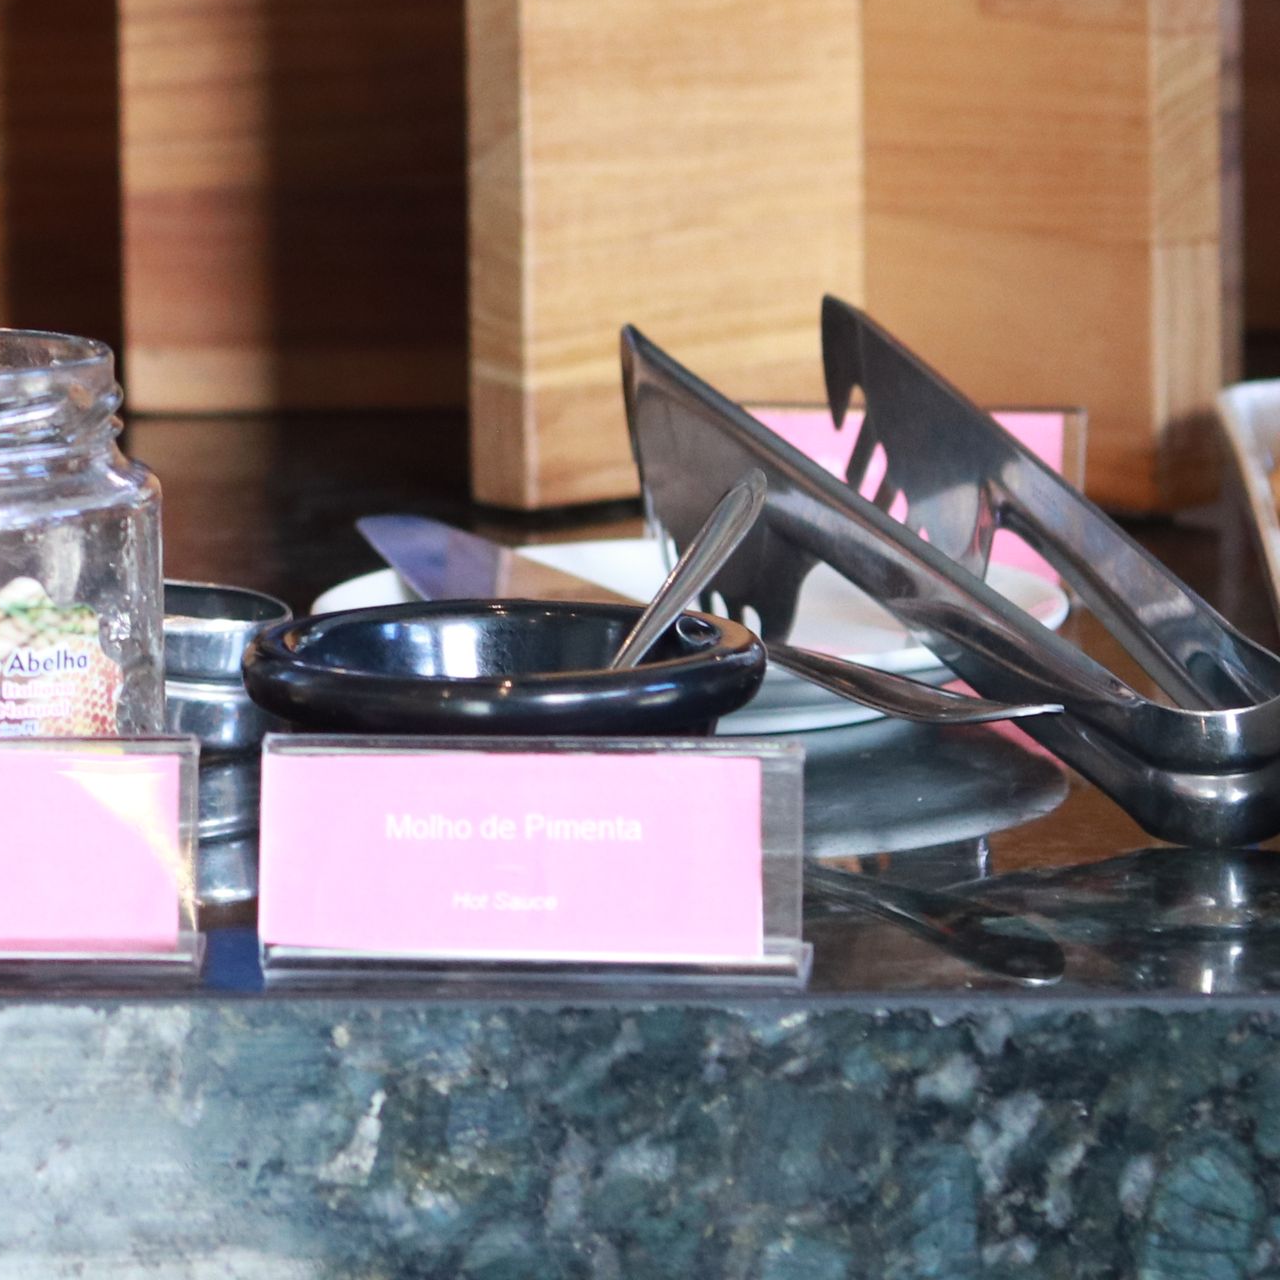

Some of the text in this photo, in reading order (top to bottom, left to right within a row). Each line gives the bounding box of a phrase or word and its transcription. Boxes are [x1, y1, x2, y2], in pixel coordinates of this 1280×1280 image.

[8, 649, 88, 673] Abelha
[384, 813, 643, 841] Molho de Pimenta
[452, 890, 558, 911] Hot Sauce
